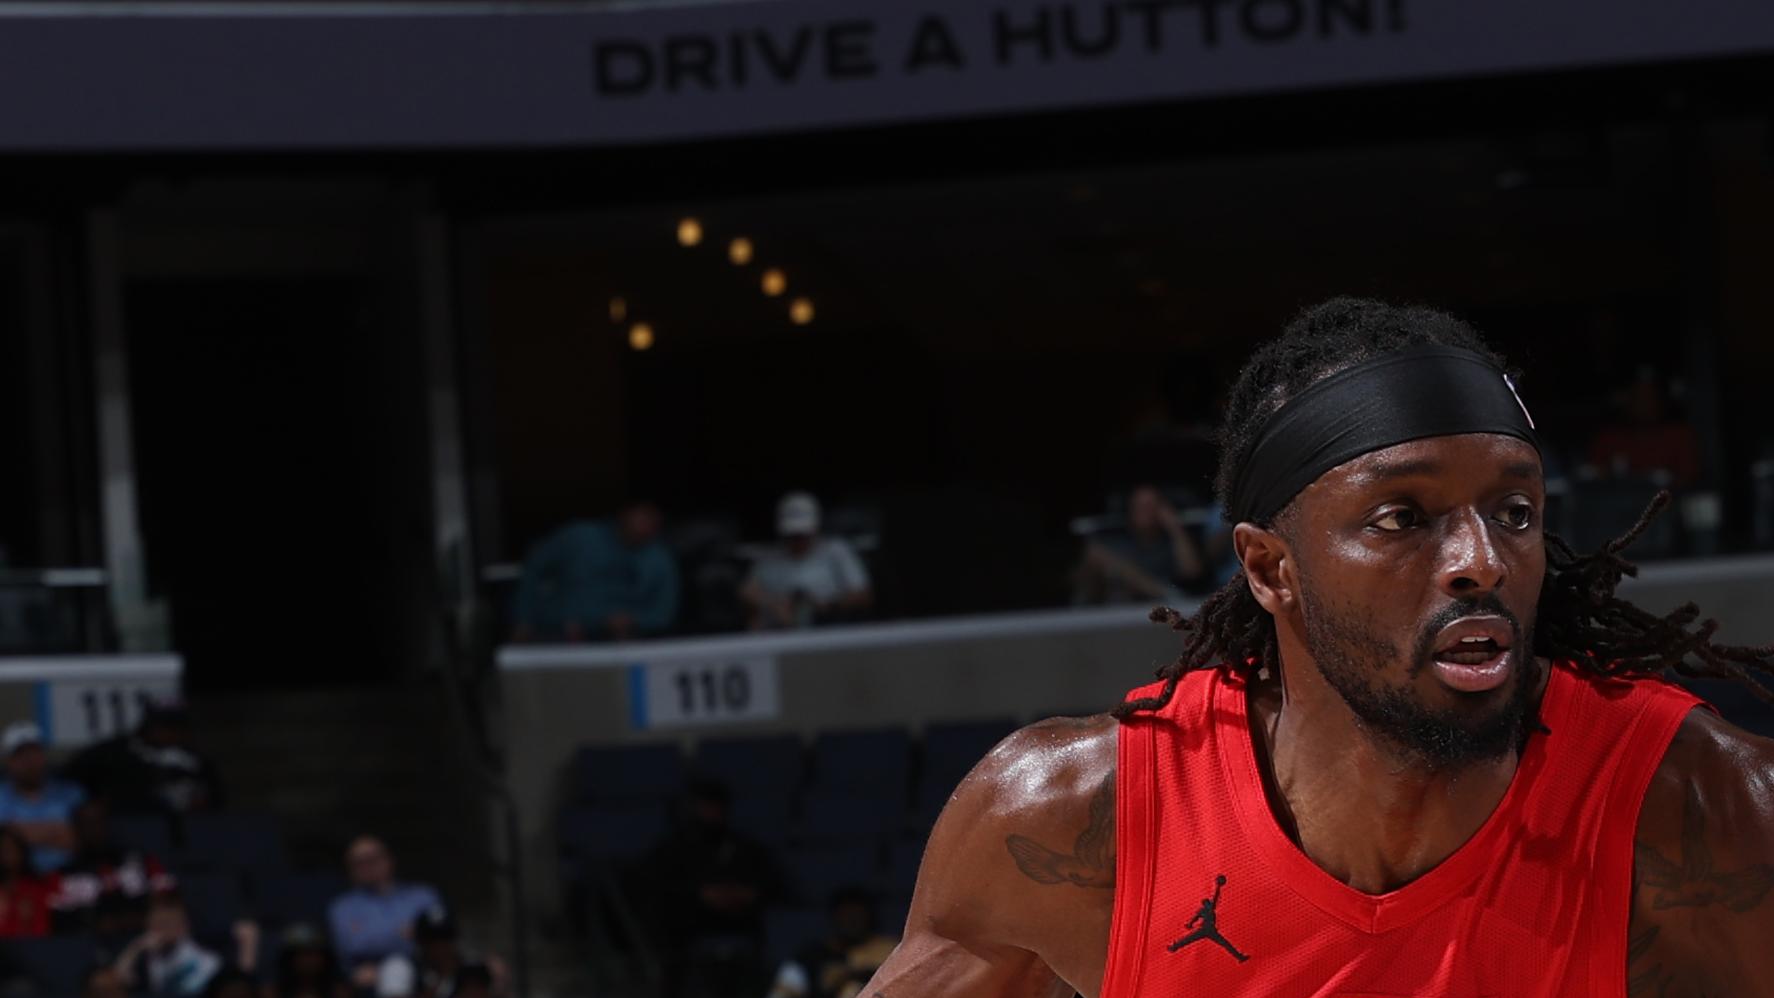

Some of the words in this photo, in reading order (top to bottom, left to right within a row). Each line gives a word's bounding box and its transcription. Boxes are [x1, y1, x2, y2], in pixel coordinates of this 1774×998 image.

[595, 20, 877, 97] DRIVE
[906, 16, 963, 72] A
[995, 0, 1405, 64] HUTTON!
[673, 664, 753, 714] 110
